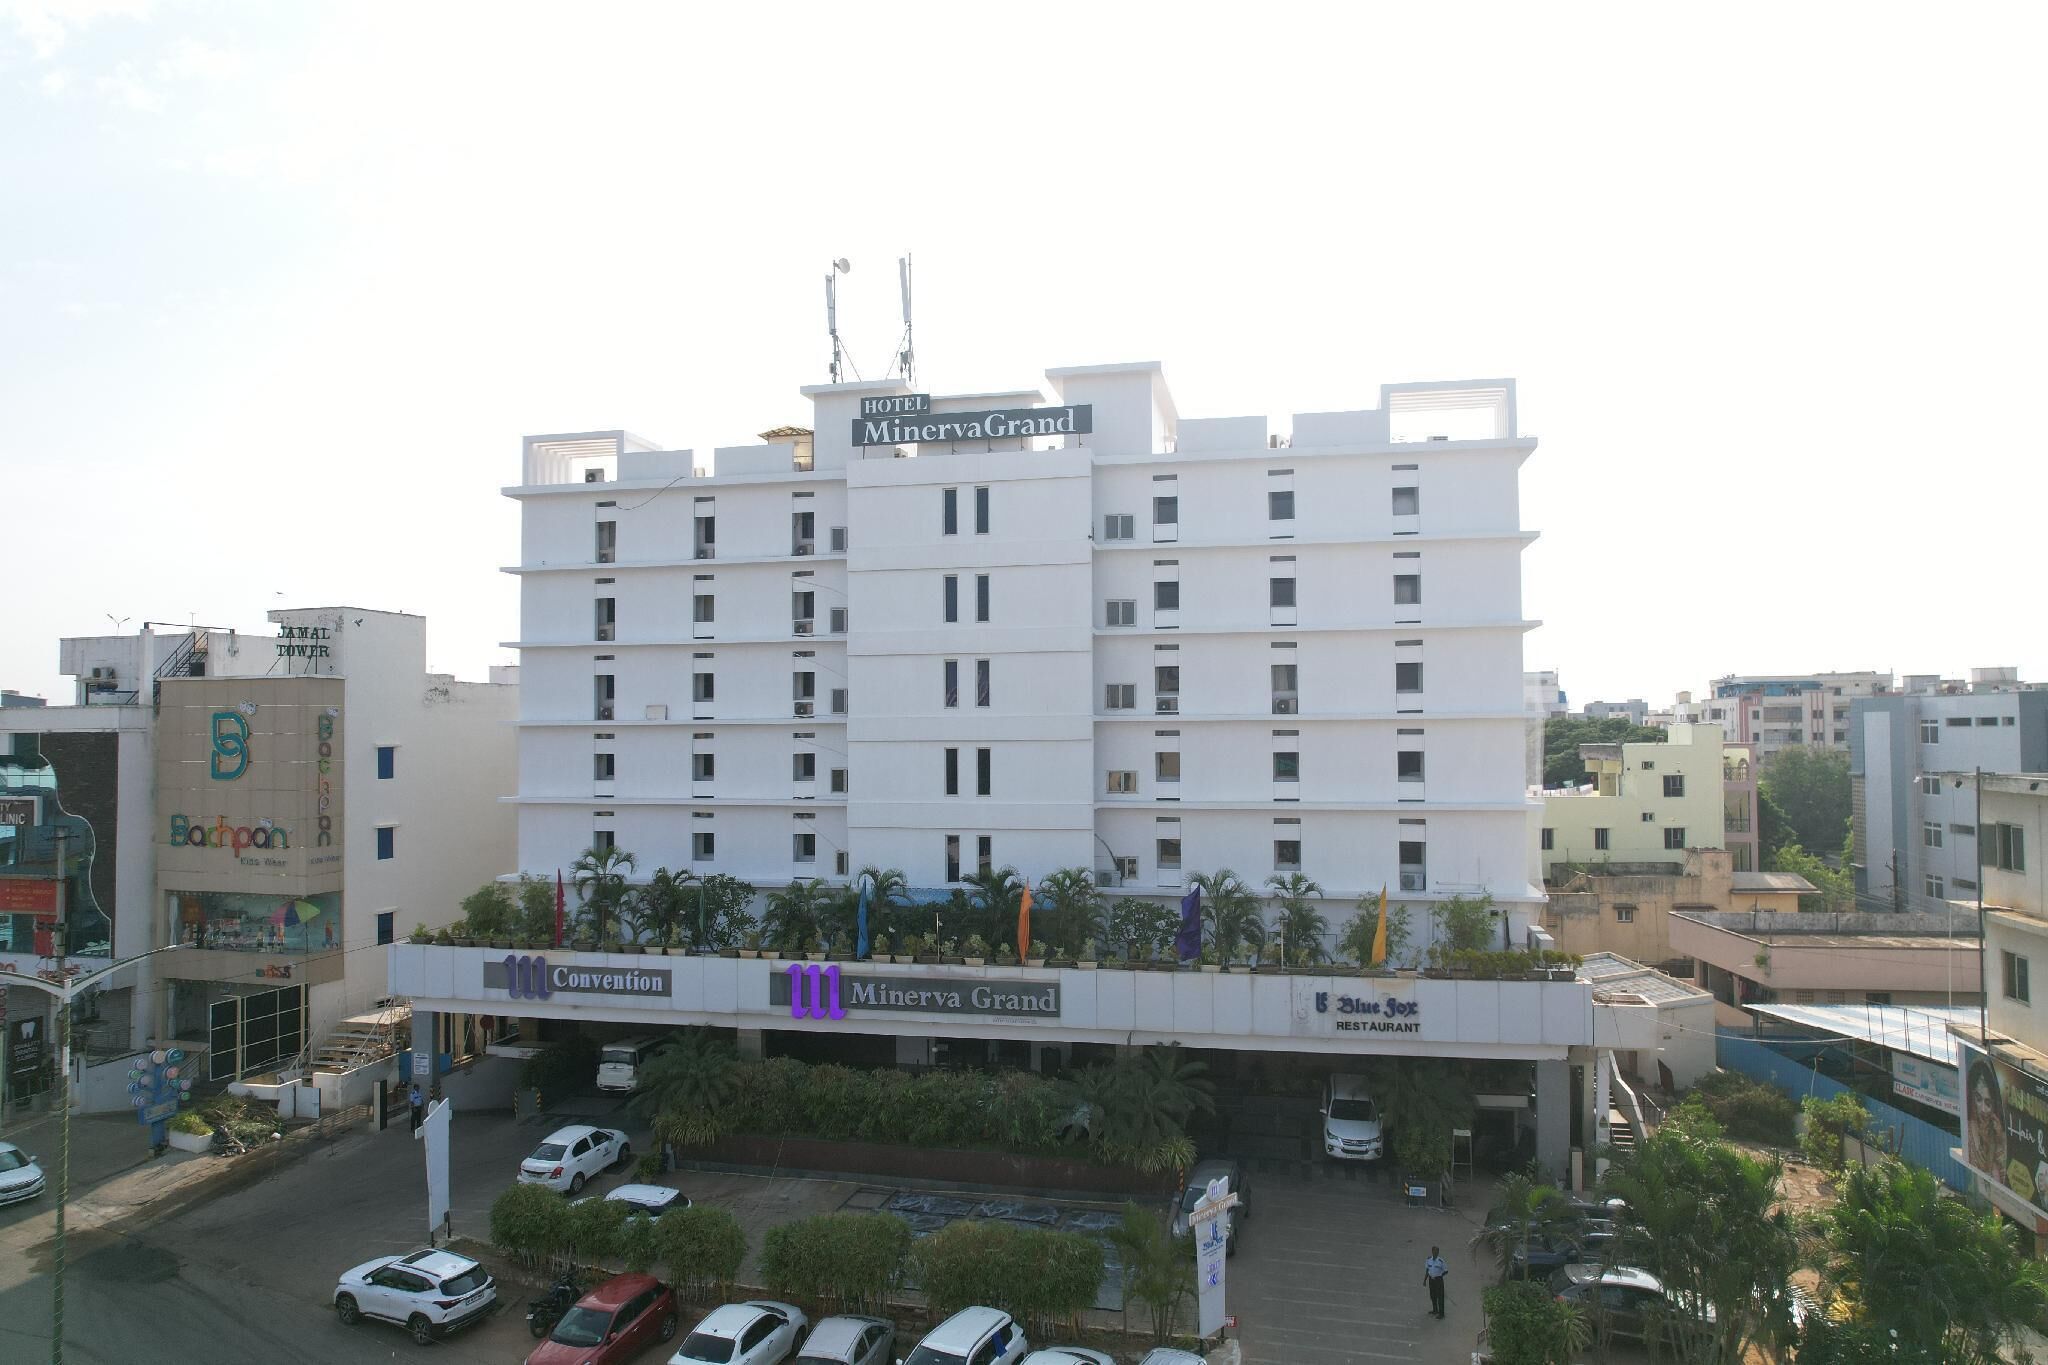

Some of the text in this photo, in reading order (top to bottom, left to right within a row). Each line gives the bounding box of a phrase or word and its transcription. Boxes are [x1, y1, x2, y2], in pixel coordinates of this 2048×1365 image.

[864, 396, 928, 414] HOTEL
[862, 408, 1077, 444] MinervaGrand
[277, 626, 331, 639] JAMAL
[276, 644, 331, 657] TOWER
[170, 814, 289, 858] Bachpan
[553, 967, 664, 992] Convention
[850, 982, 962, 1008] Minerva
[971, 986, 1058, 1012] Grand
[1337, 997, 1419, 1018] Blue Fox
[1336, 1021, 1421, 1033] RESTAURANT
